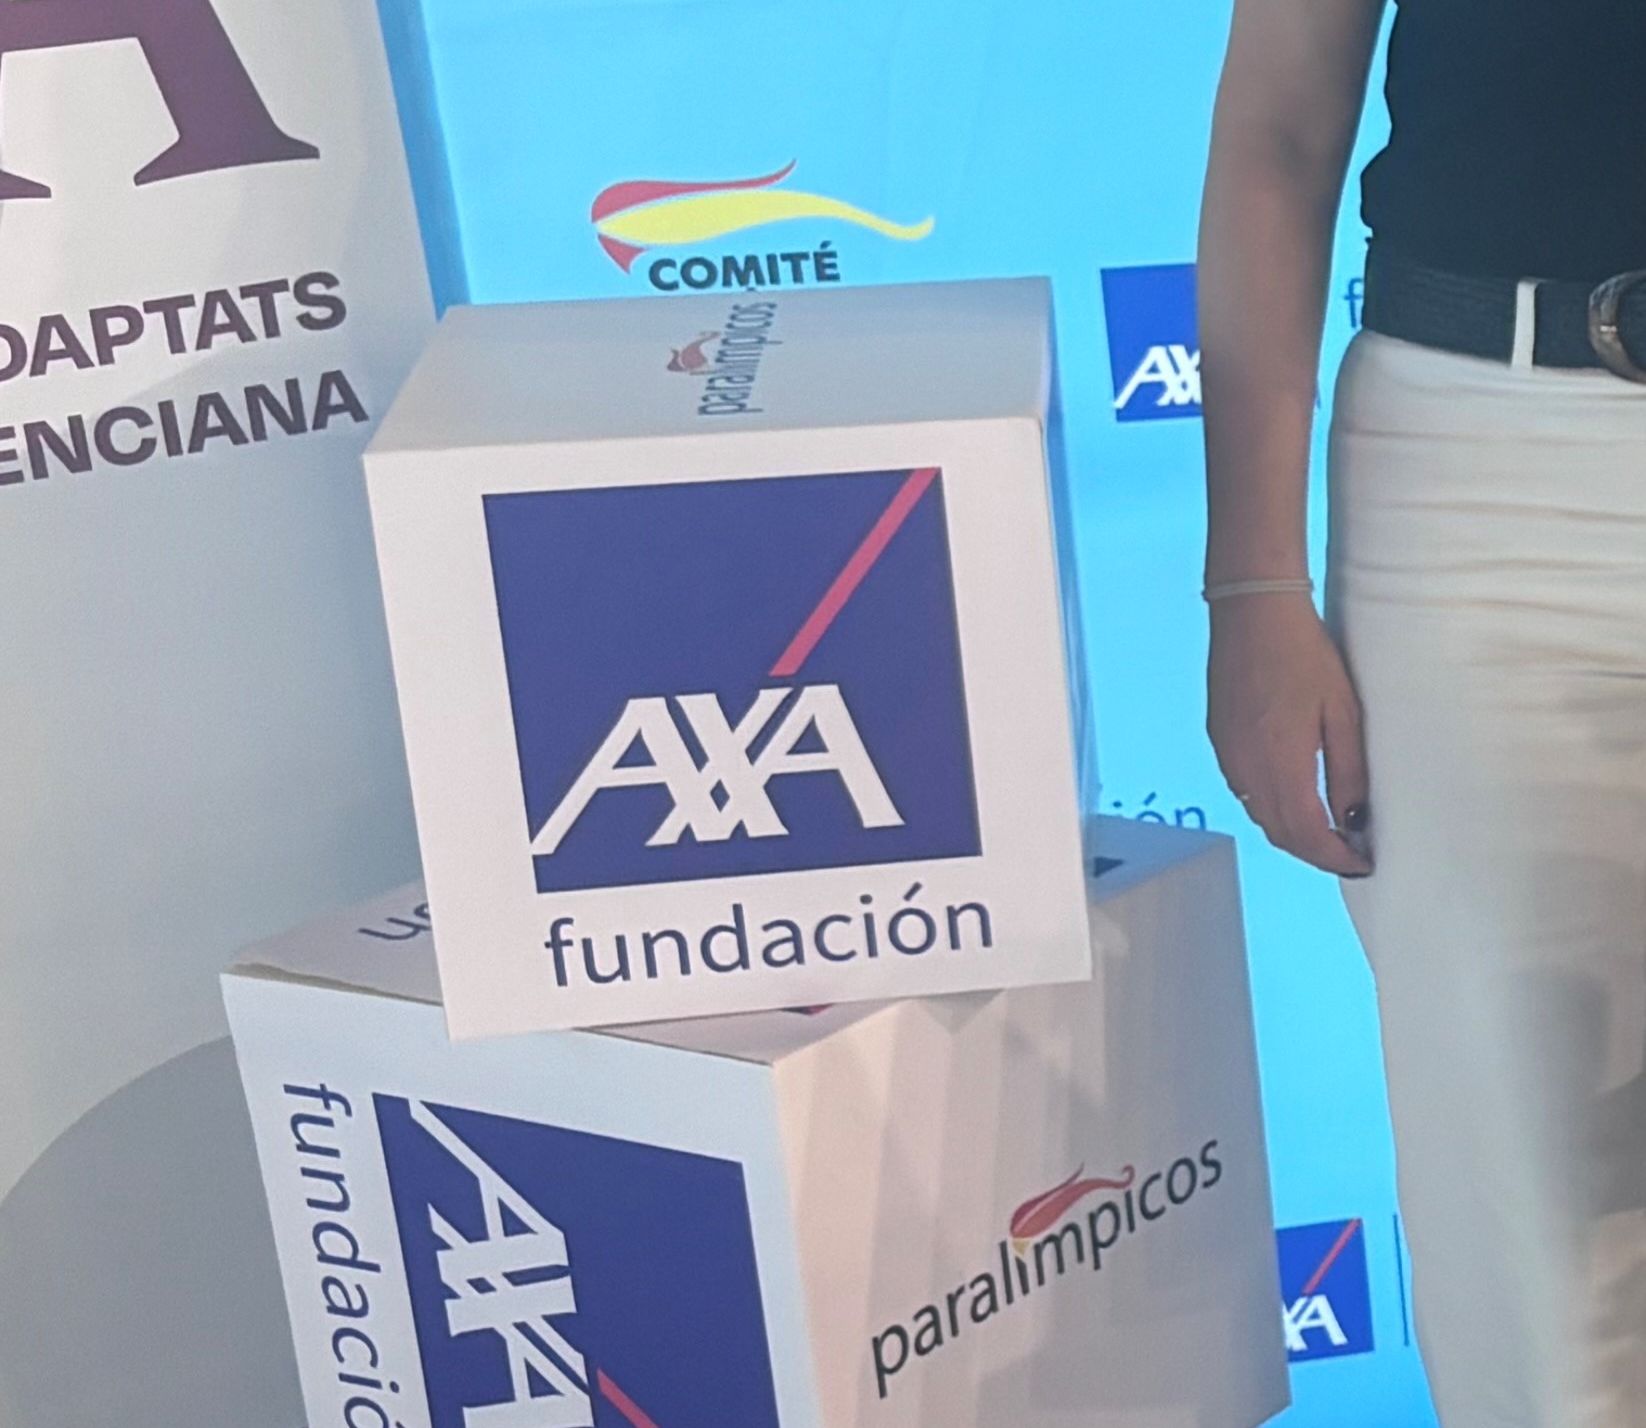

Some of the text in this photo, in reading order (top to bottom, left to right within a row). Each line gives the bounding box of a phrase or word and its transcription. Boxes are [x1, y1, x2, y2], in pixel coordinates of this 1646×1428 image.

[648, 241, 840, 292] COMITÉ
[529, 684, 907, 856] AXA
[543, 883, 994, 987] fundación
